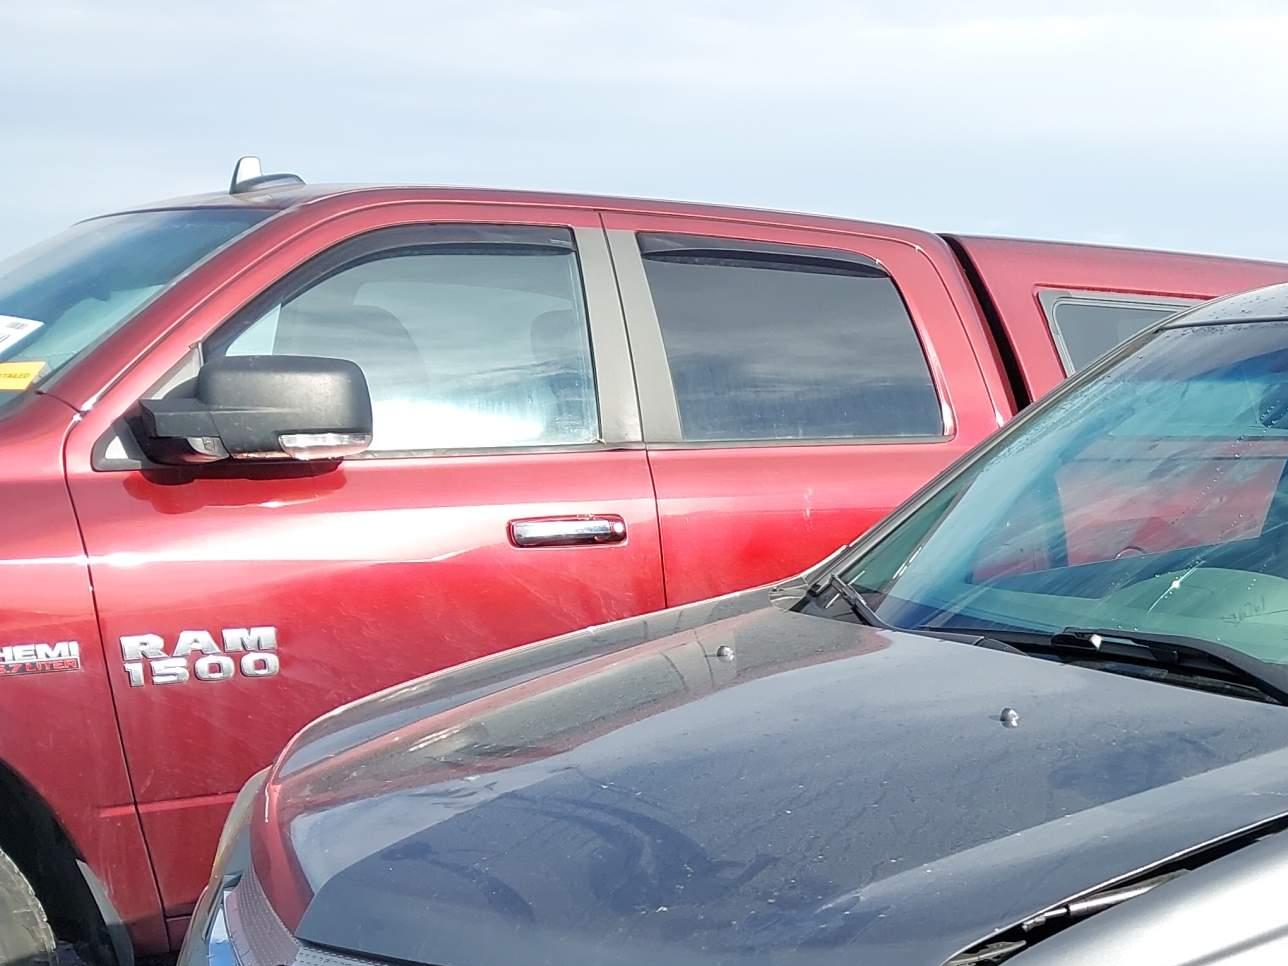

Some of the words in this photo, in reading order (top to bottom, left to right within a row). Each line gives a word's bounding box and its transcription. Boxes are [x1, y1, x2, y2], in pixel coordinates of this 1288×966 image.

[120, 626, 277, 660] RAM
[25, 658, 77, 672] LITER
[124, 653, 279, 686] 1500
